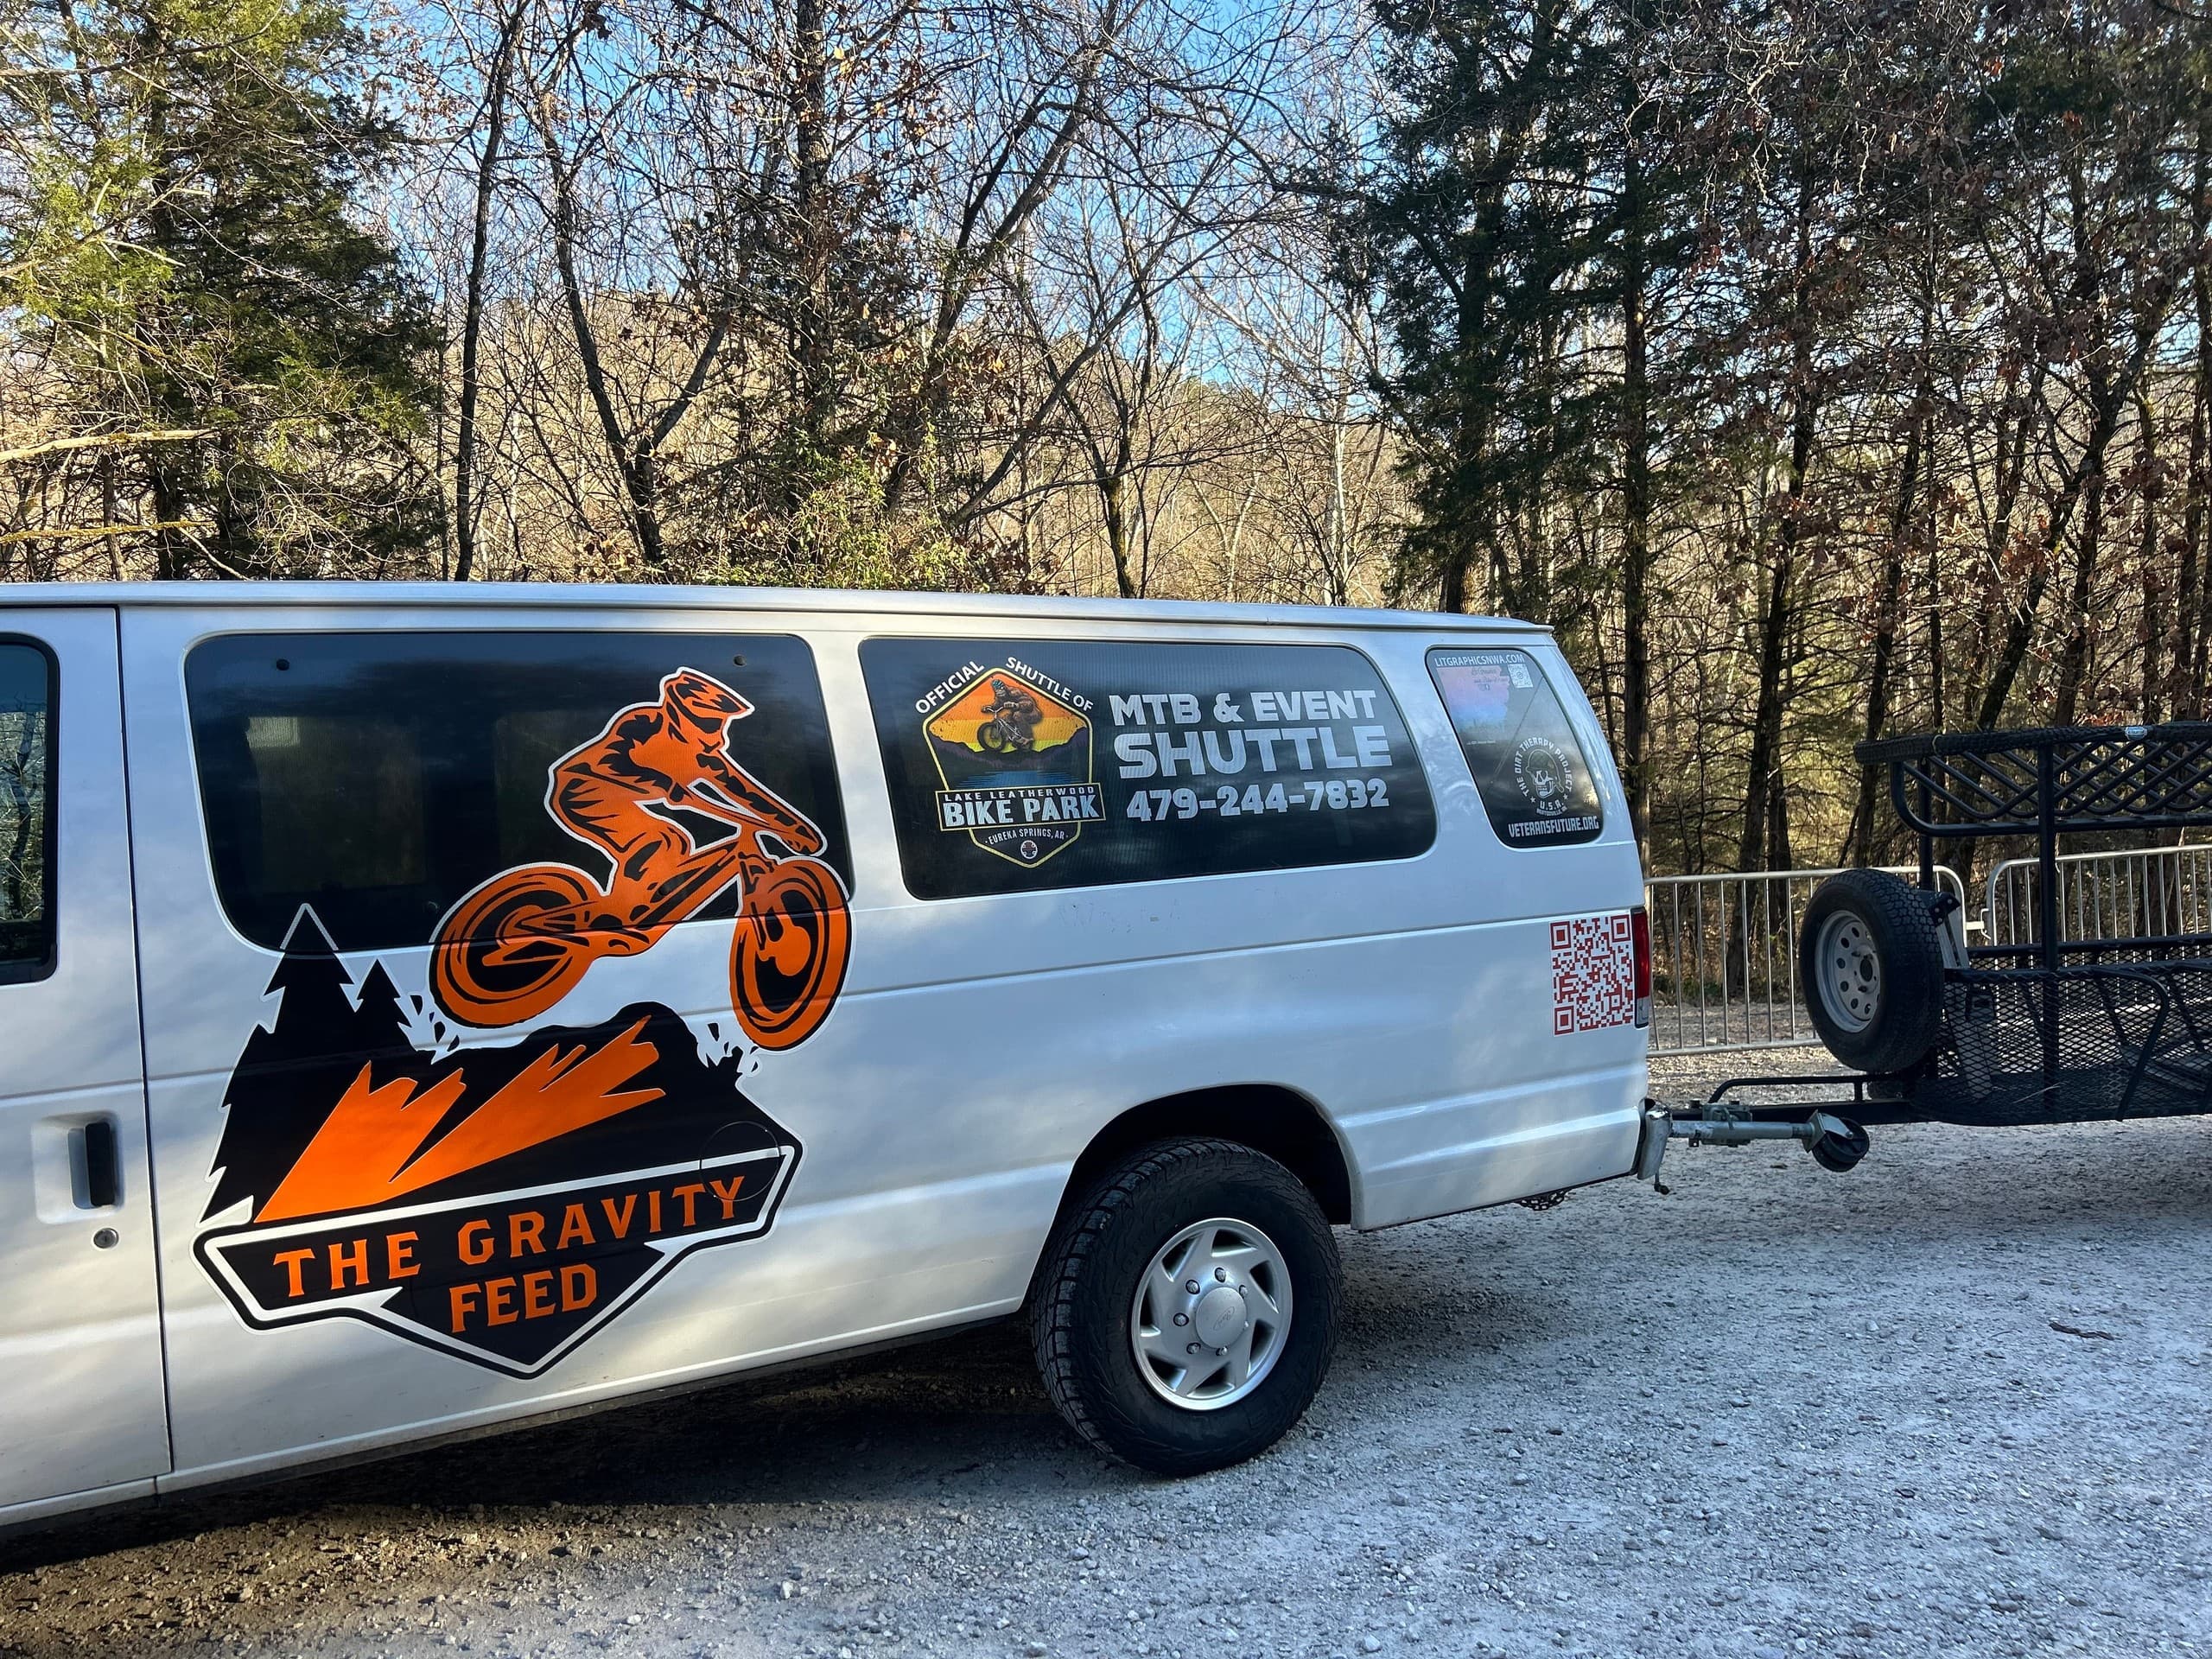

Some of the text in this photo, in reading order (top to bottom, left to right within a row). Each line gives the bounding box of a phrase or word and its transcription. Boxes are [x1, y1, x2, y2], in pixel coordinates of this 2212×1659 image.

[1434, 654, 1525, 667] LITGRAPHICSNWA.COM
[915, 657, 1094, 714] OFFICIAL SHUTTLE OF
[1109, 690, 1376, 726] MTB & EVENT
[1113, 725, 1393, 779] SHUTTLE
[1514, 737, 1573, 797] THE DIRT THERAPY PROJECT
[943, 794, 1100, 828] BIKE PARK
[944, 786, 1095, 802] LAKE LEATHERWOOD
[1126, 778, 1390, 822] 479-244-7832
[1539, 799, 1565, 810] U.S.A.
[988, 829, 1018, 845] EUREKA
[1054, 830, 1065, 841] AR
[1508, 815, 1599, 838] VETERANSFUTURE.ORG
[272, 1174, 746, 1298] THE GRAVITY
[448, 1262, 597, 1334] FEED
